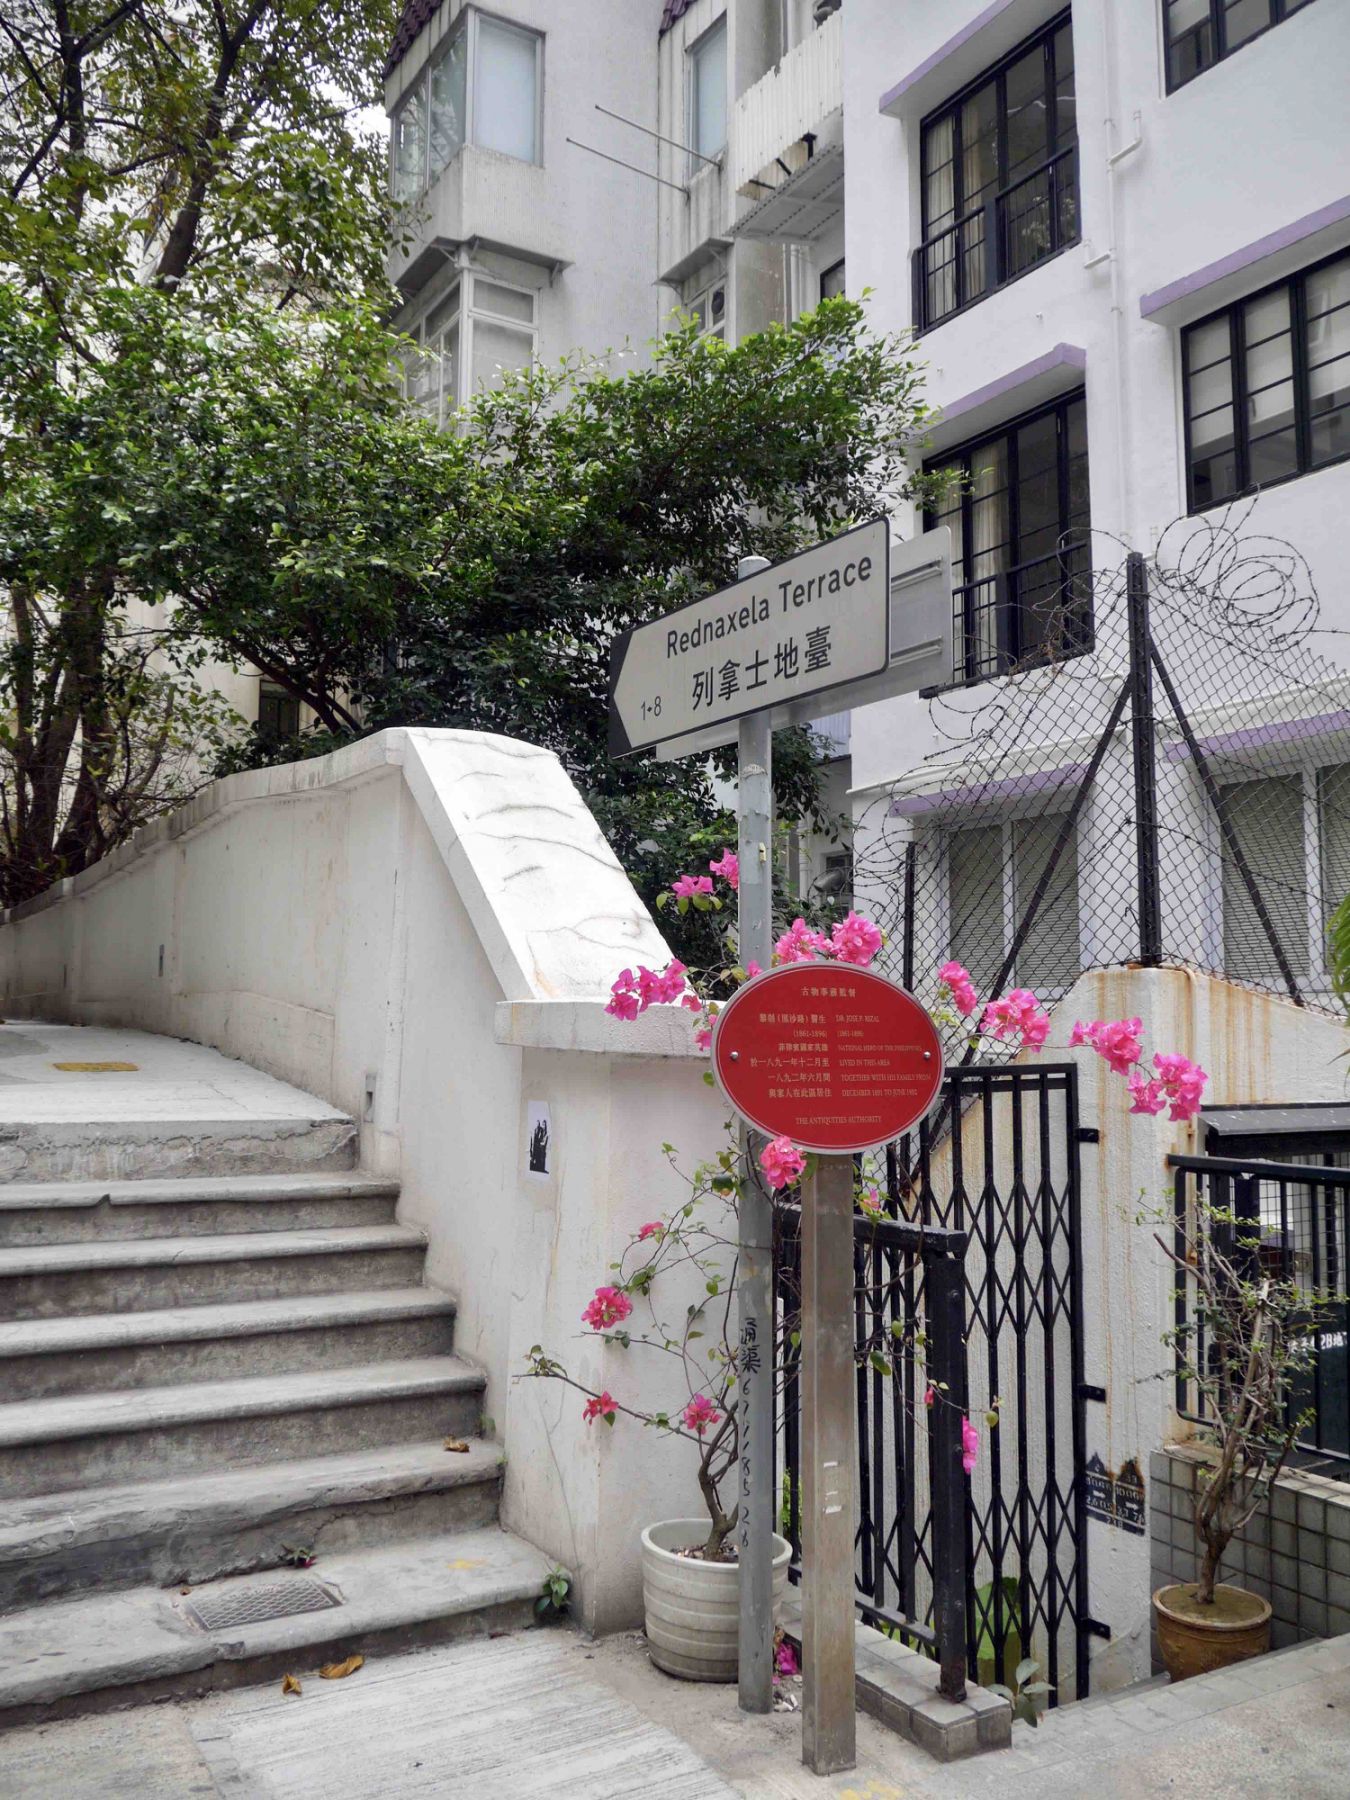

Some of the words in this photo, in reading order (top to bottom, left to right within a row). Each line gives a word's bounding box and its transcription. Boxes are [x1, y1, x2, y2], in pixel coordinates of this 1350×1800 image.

[667, 595, 770, 659] Rednaxela
[778, 556, 872, 613] Terrace
[692, 625, 832, 711] 列拿士地臺
[795, 1117, 808, 1125] THE
[809, 1116, 847, 1126] ANTIQUITIES
